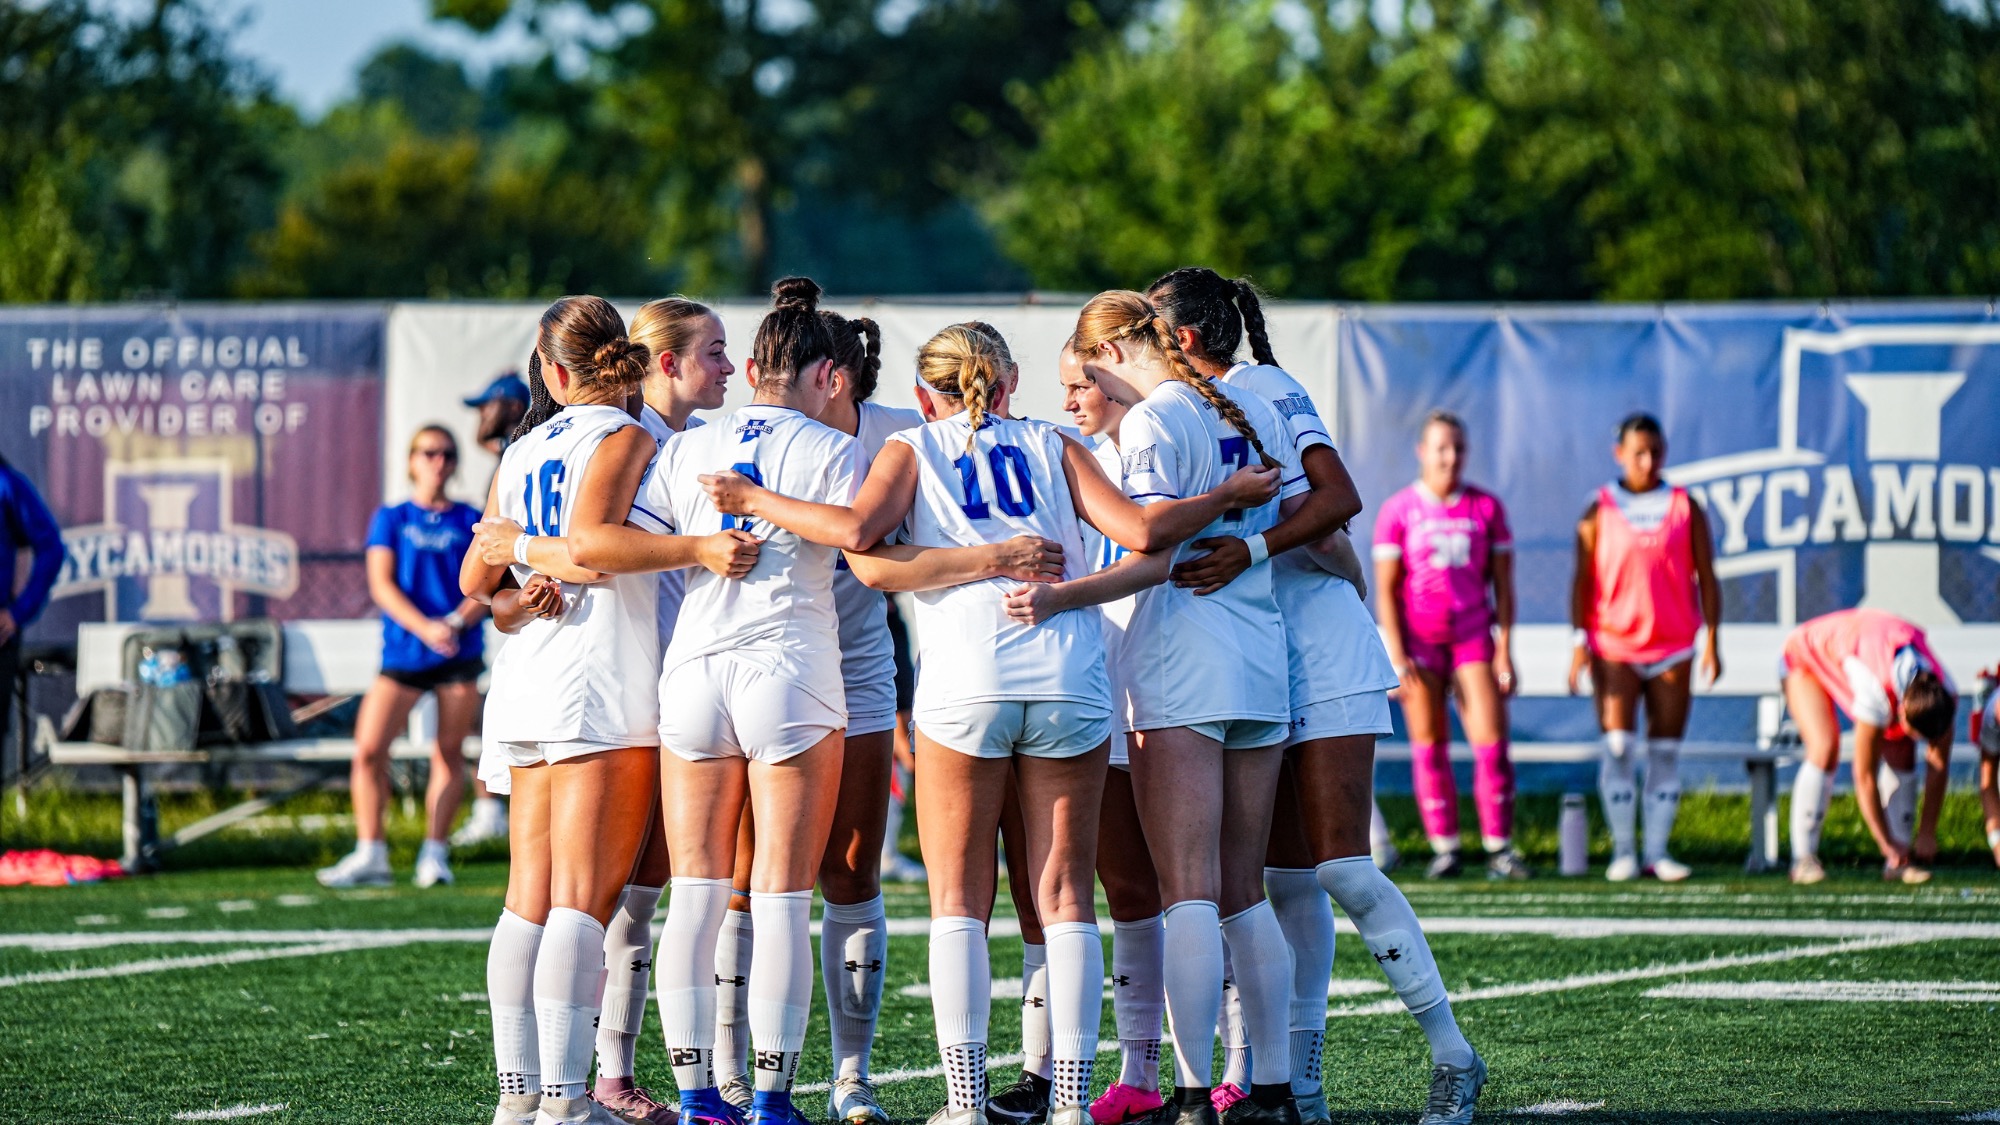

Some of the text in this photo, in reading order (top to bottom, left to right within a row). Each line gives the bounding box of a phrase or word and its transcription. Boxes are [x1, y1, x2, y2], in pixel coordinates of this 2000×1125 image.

[27, 336, 309, 369] THE OFFICIAL
[53, 369, 286, 403] LAWN CARE
[29, 402, 308, 438] PROVIDER OF
[523, 458, 566, 537] 16
[953, 443, 1037, 520] 10
[60, 531, 288, 586] YCAMORES
[755, 1049, 781, 1071] FS
